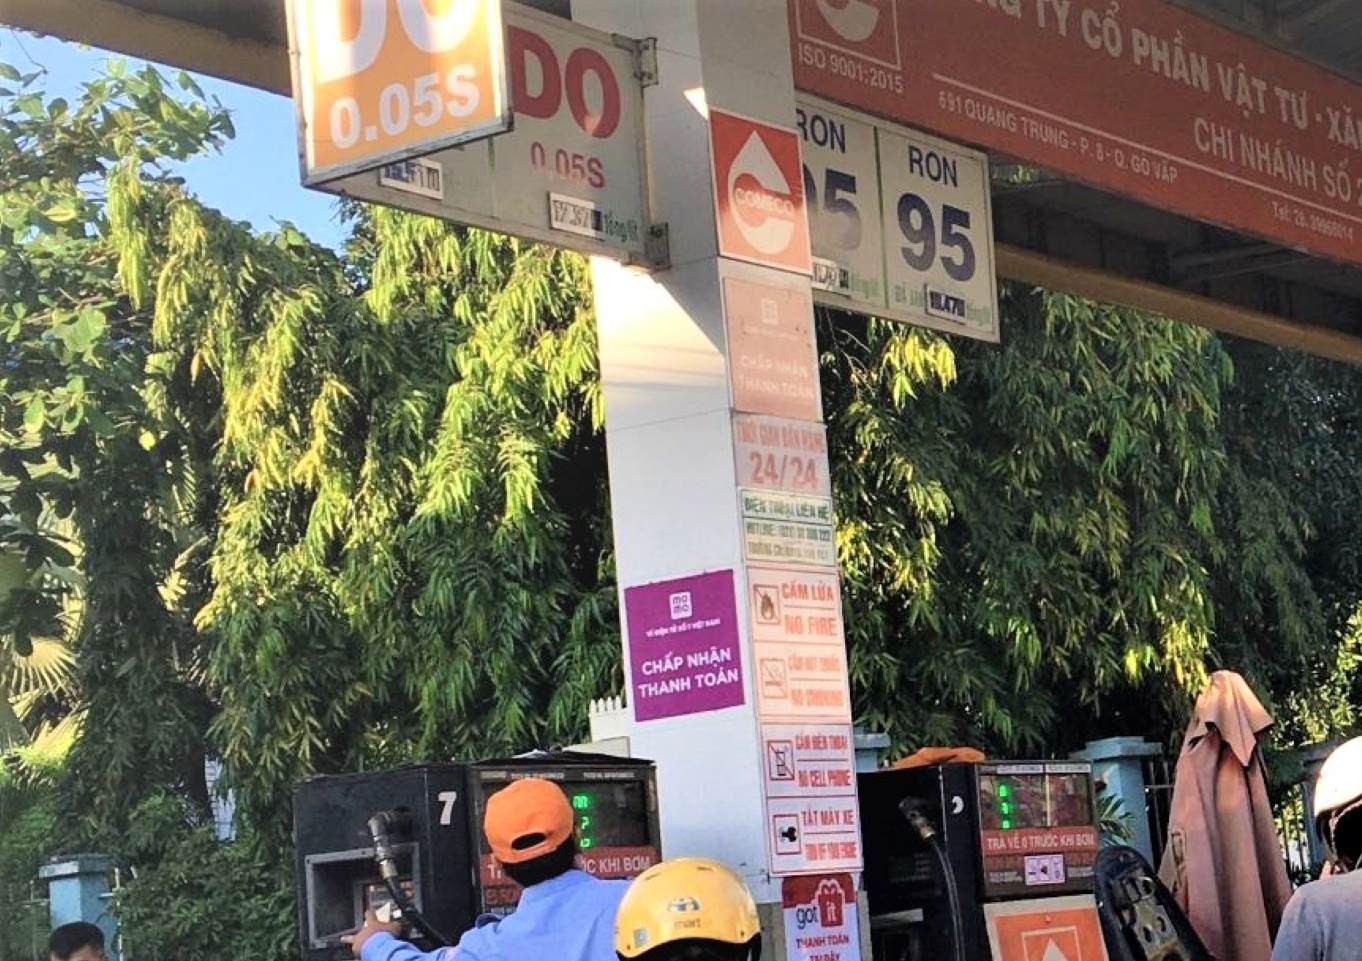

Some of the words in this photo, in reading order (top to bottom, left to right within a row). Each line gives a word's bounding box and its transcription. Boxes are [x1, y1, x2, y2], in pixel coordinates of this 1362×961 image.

[507, 24, 621, 138] DO
[798, 43, 826, 70] ISO
[830, 57, 904, 94] 9001:2015
[1081, 2, 1123, 57] CỔ
[1131, 28, 1209, 92] PHẦN
[1215, 62, 1267, 118] VẬT
[1274, 87, 1308, 129] TƯ
[329, 62, 481, 149] 0.05S
[964, 98, 1016, 132] QUANG
[1020, 117, 1069, 148] TRUNG
[796, 108, 846, 154] RON
[907, 145, 959, 188] RON
[1193, 117, 1235, 162] CHI
[1239, 134, 1318, 191] NHÁNH
[1322, 158, 1352, 203] SỐ
[897, 192, 976, 282] 95
[750, 452, 817, 490] 24/24
[781, 580, 809, 600] CẤM
[784, 614, 803, 635] NO
[808, 615, 838, 637] FIRE
[642, 650, 683, 676] CHẤP
[686, 645, 732, 669] NHẬN
[637, 676, 691, 699] THANH
[694, 667, 739, 688] TOÁN
[439, 791, 457, 825] 7
[600, 858, 620, 874] KHI
[623, 854, 651, 871] BƠM
[674, 918, 702, 929] mart
[826, 900, 838, 922] it
